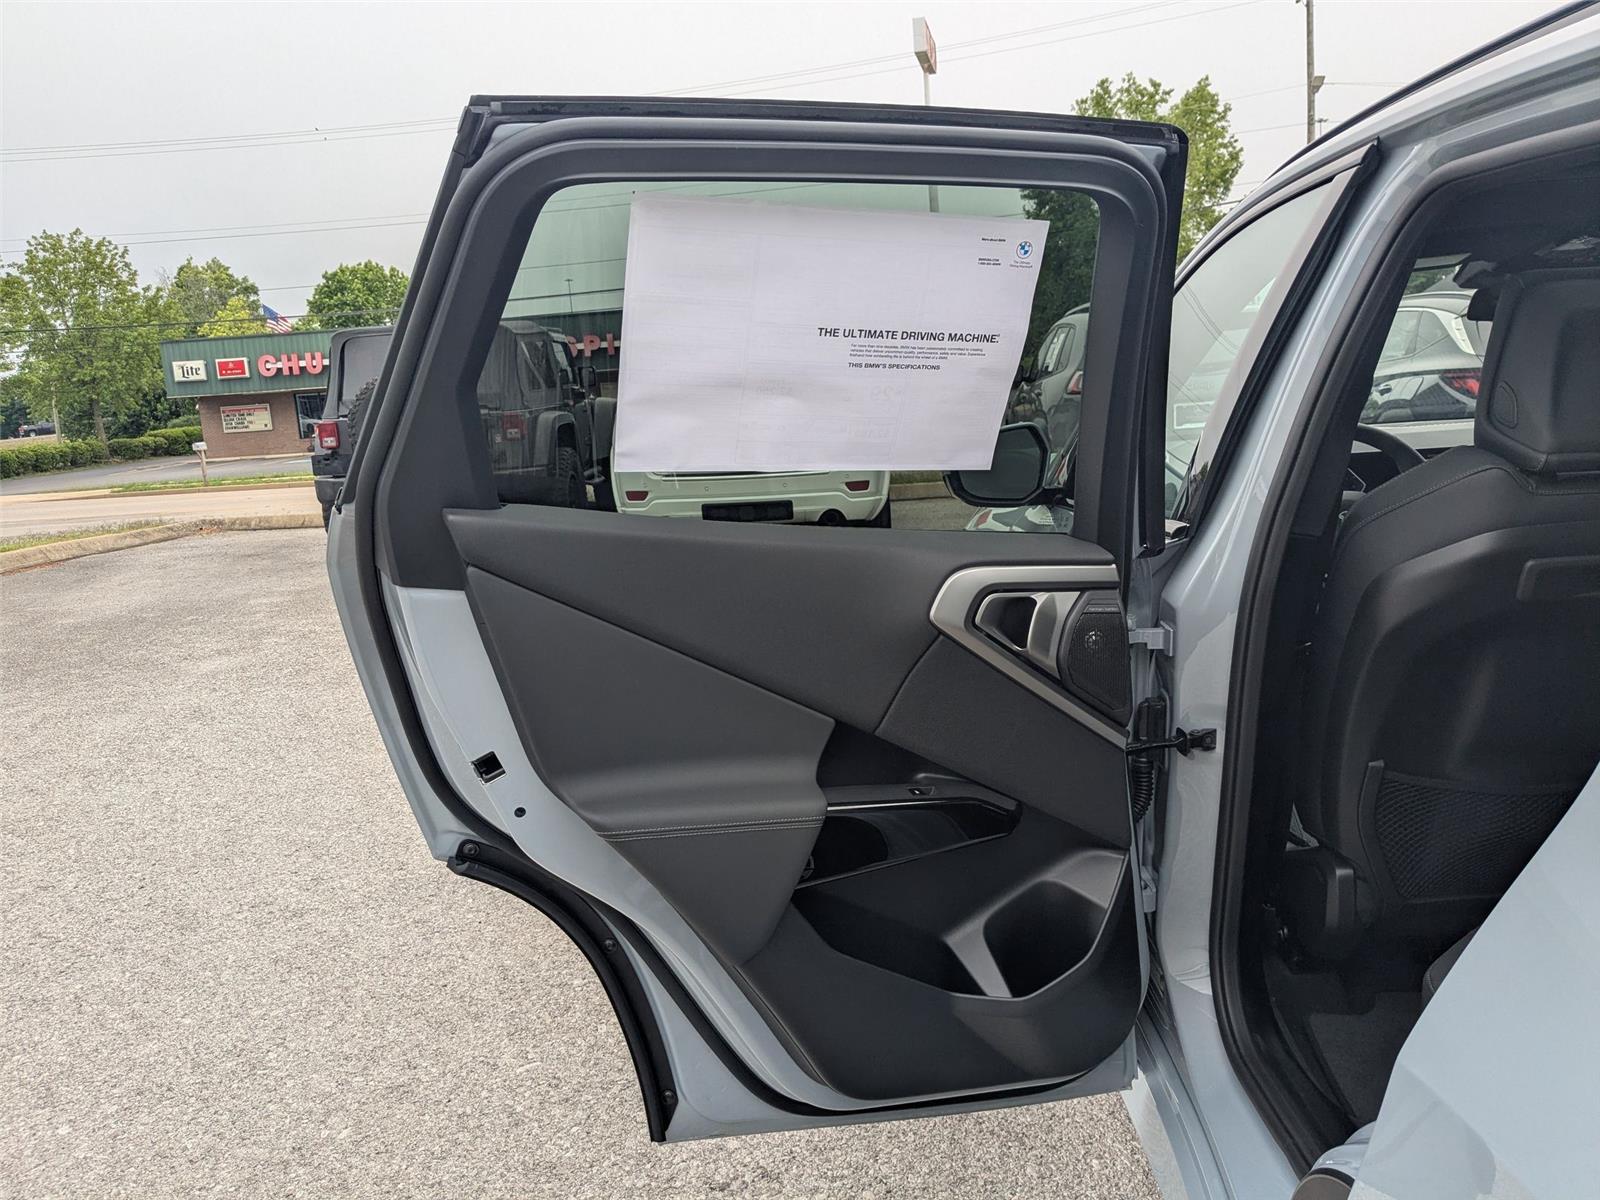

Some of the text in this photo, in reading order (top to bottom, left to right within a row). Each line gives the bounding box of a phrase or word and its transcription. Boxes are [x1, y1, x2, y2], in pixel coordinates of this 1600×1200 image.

[817, 327, 840, 338] THE
[842, 328, 898, 340] ULTIMATE
[900, 331, 945, 342] DRIVING
[257, 351, 323, 377] CHU
[181, 366, 200, 378] Lite
